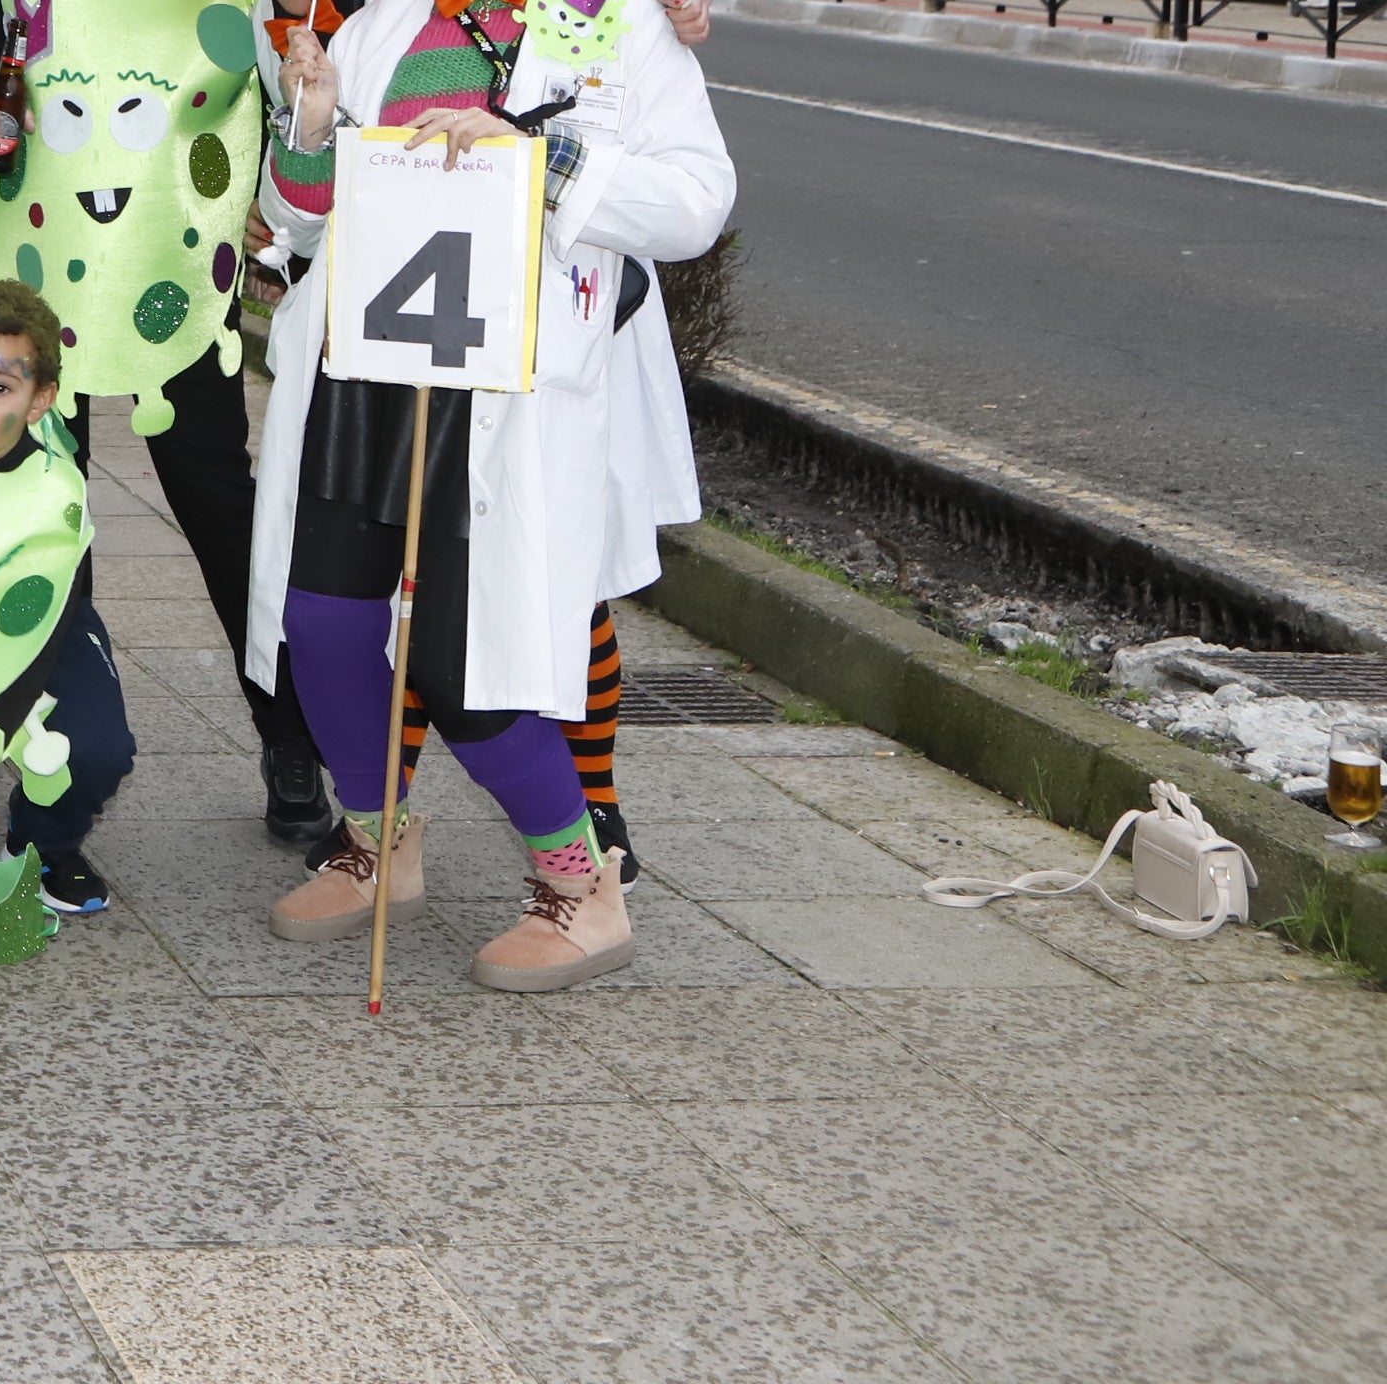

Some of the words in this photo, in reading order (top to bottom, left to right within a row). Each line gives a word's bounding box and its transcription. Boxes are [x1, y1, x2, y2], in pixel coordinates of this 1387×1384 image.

[369, 152, 406, 166] CEPA
[414, 158, 493, 173] BAREREÑA
[363, 230, 486, 369] 4
